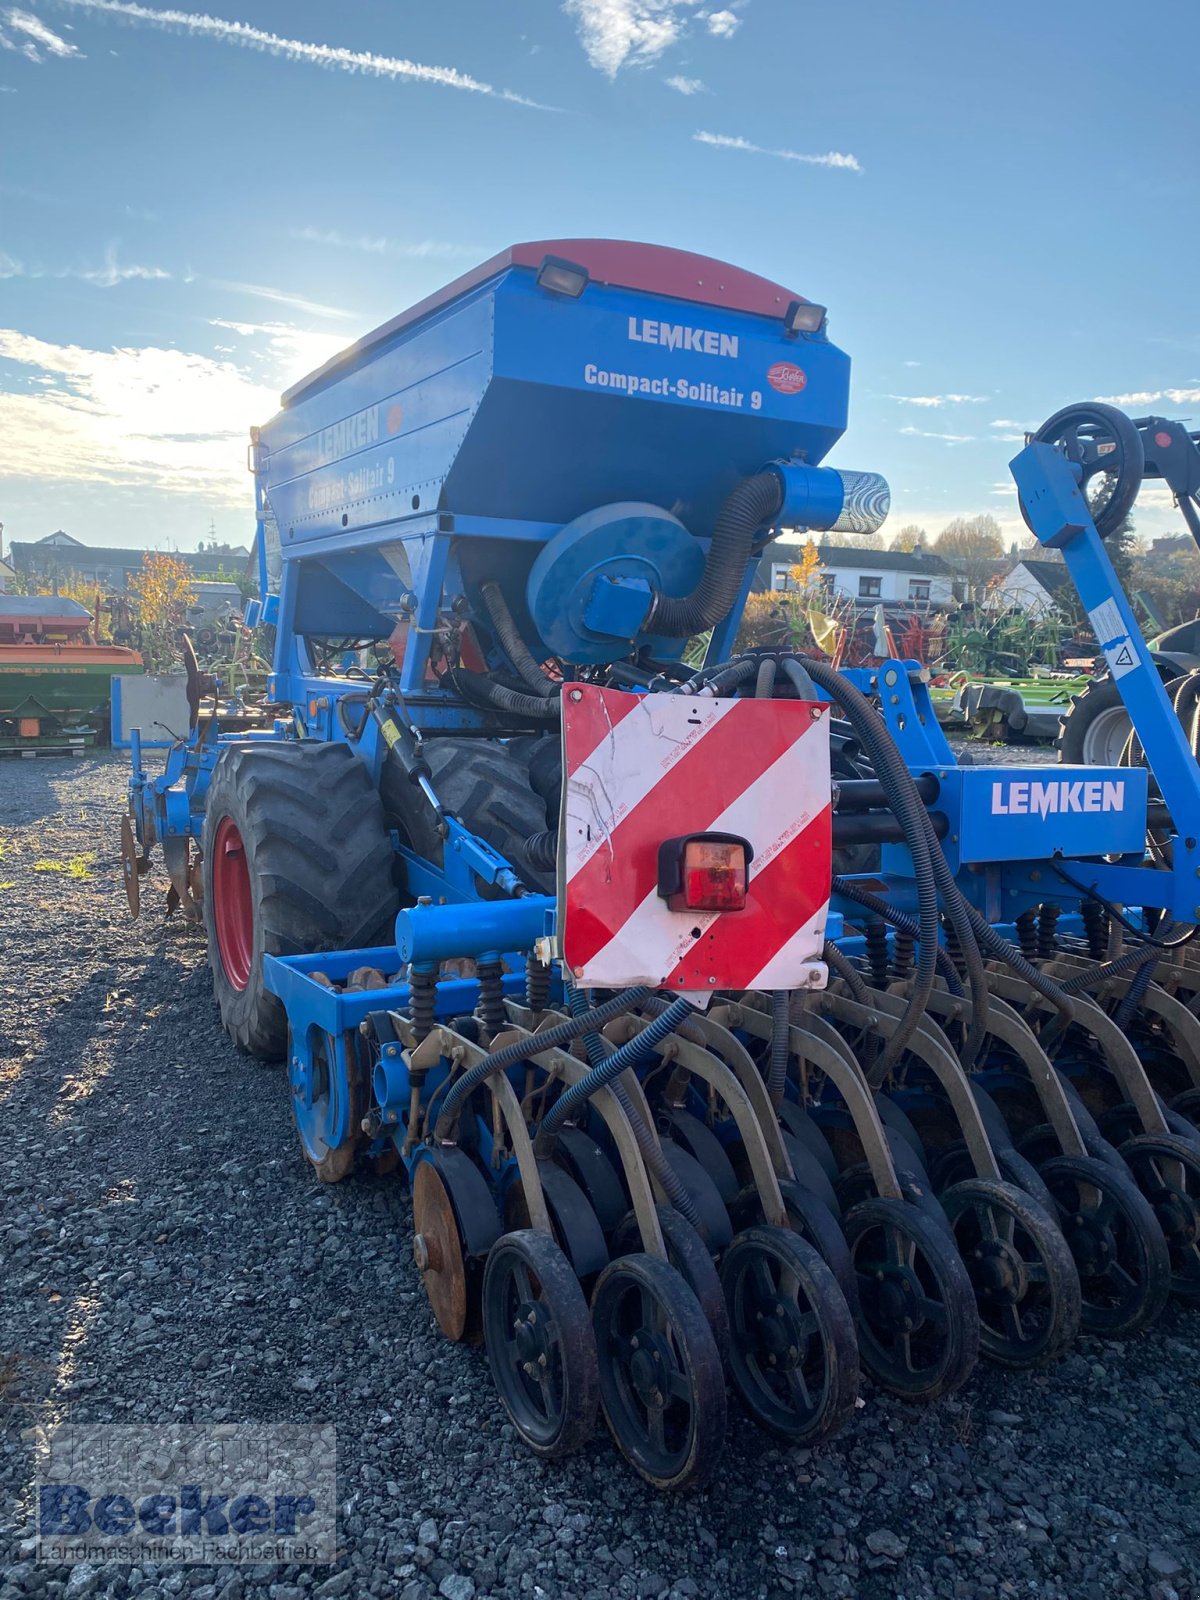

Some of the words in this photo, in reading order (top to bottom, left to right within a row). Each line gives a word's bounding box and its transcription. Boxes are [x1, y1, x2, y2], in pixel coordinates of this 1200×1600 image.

[628, 317, 739, 358] LEMKEN
[584, 364, 744, 407] Compact-Solitair
[751, 391, 763, 410] 9
[318, 404, 380, 460] LEMKEN
[387, 456, 396, 484] 9
[991, 781, 1125, 822] LEMKEN
